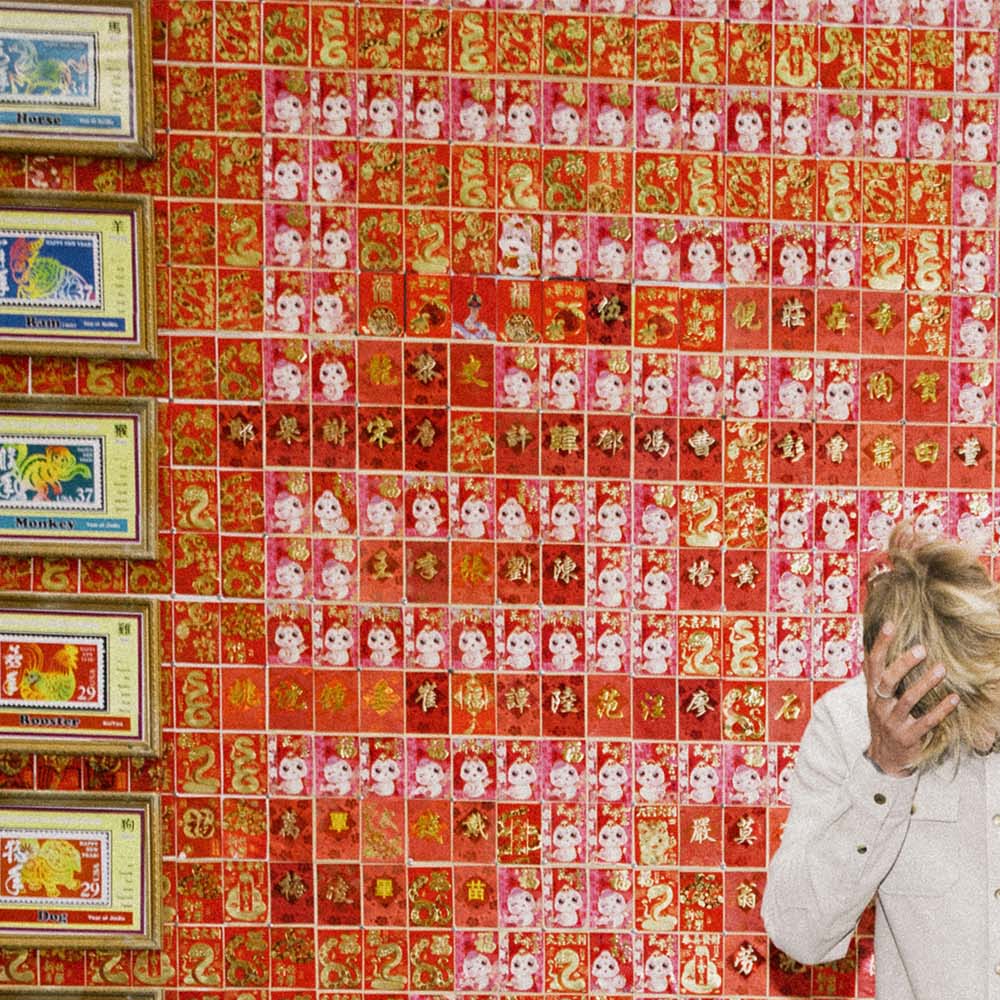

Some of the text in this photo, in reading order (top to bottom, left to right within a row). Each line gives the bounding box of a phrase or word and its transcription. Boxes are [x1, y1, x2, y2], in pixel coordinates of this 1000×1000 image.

[16, 112, 61, 125] Horse
[26, 315, 60, 328] Ram
[367, 417, 397, 449] 宋
[506, 425, 532, 452] 許
[914, 440, 940, 464] 田
[76, 488, 93, 502] 37
[16, 518, 75, 532] Monkey
[372, 550, 393, 580] 王
[503, 555, 532, 584] 劉
[553, 554, 581, 584] 陳
[687, 560, 716, 588] 楊
[77, 686, 97, 700] 29
[416, 681, 439, 712] 崔
[503, 687, 532, 717] 譚
[551, 687, 579, 715] 陸
[596, 687, 624, 720] 范
[686, 690, 716, 718] 廖
[744, 685, 765, 708] 福
[774, 693, 802, 721] 石
[20, 714, 80, 727] Rooster
[184, 808, 214, 839] 福
[690, 816, 717, 844] 嚴
[734, 817, 758, 845] 莫
[80, 881, 100, 898] 29
[466, 879, 487, 901] 苗
[735, 881, 757, 909] 翁
[37, 911, 68, 924] Dog
